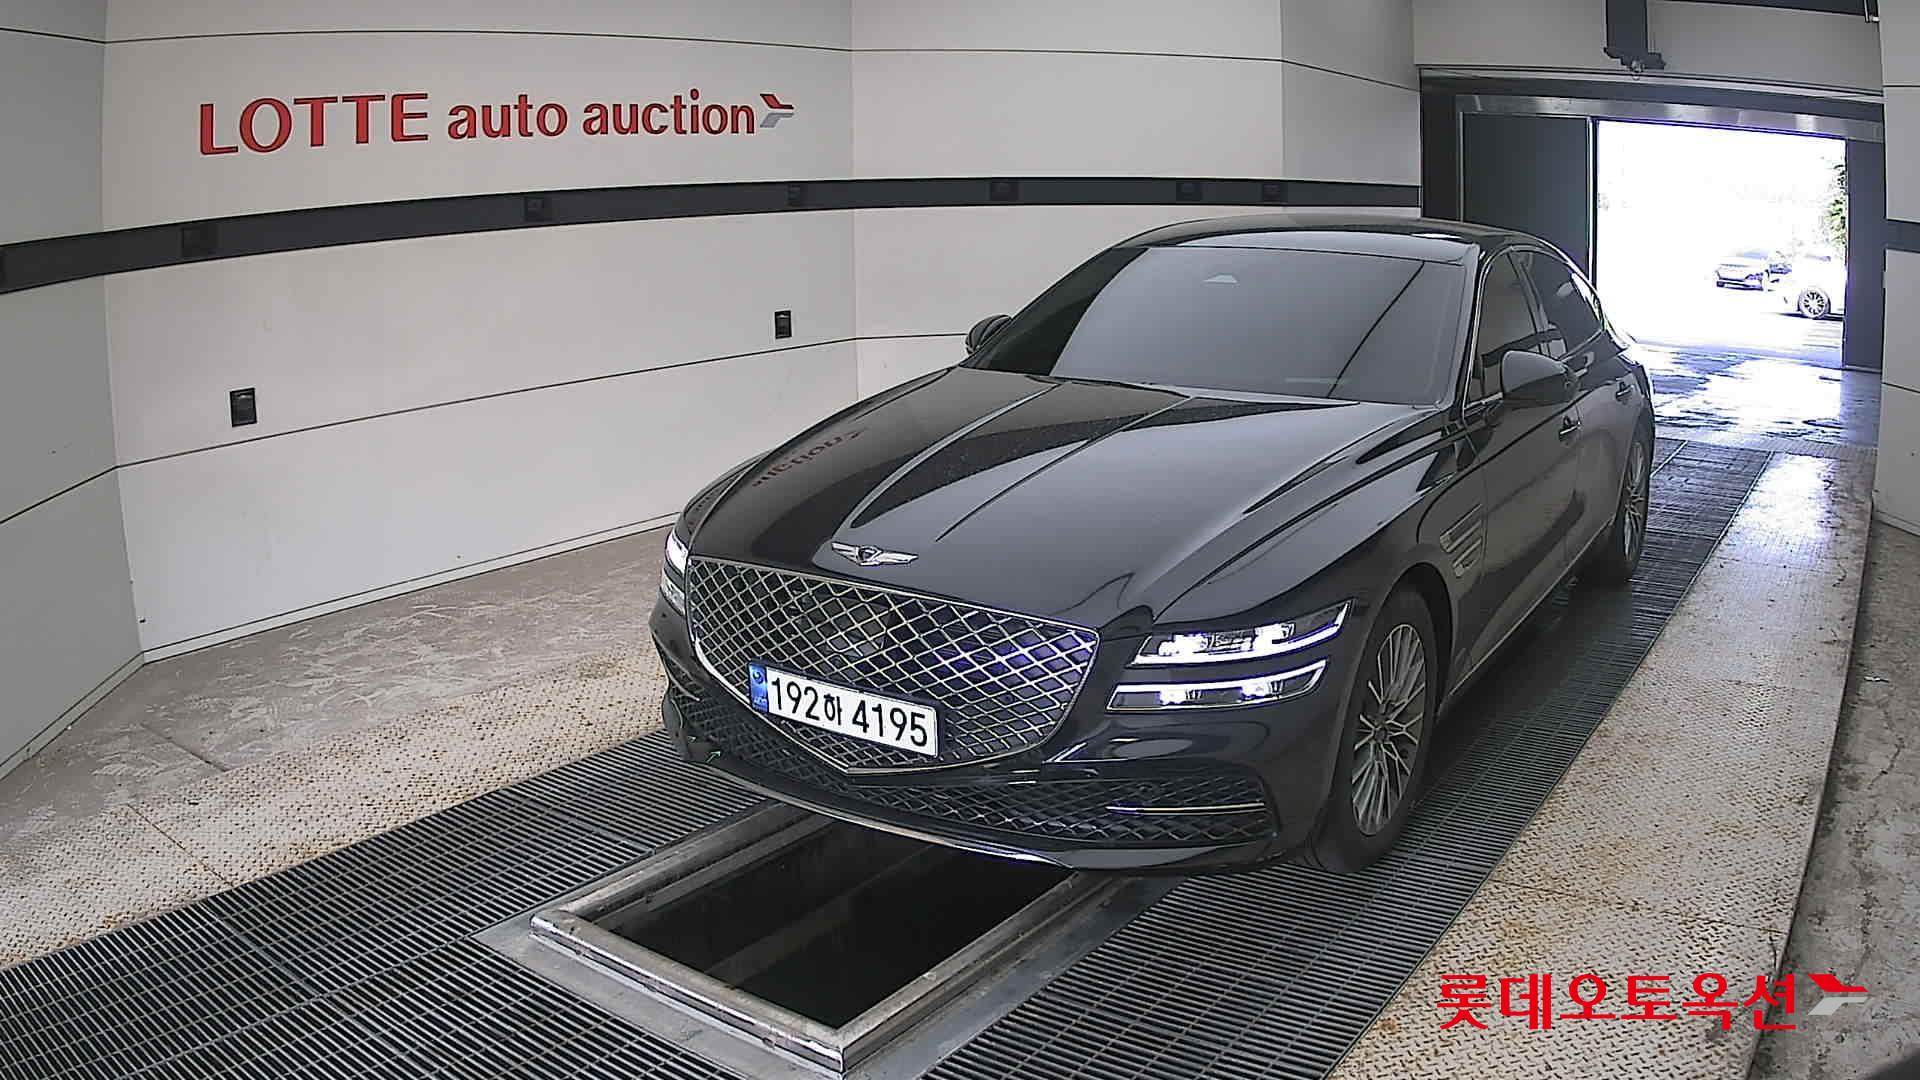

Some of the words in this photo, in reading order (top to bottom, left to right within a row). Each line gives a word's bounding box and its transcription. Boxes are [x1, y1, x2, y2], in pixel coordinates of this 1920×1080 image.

[199, 93, 428, 156] LOTTE
[447, 94, 568, 140] auto
[582, 88, 755, 135] auction
[771, 677, 843, 726] 192하
[852, 700, 928, 748] 4195
